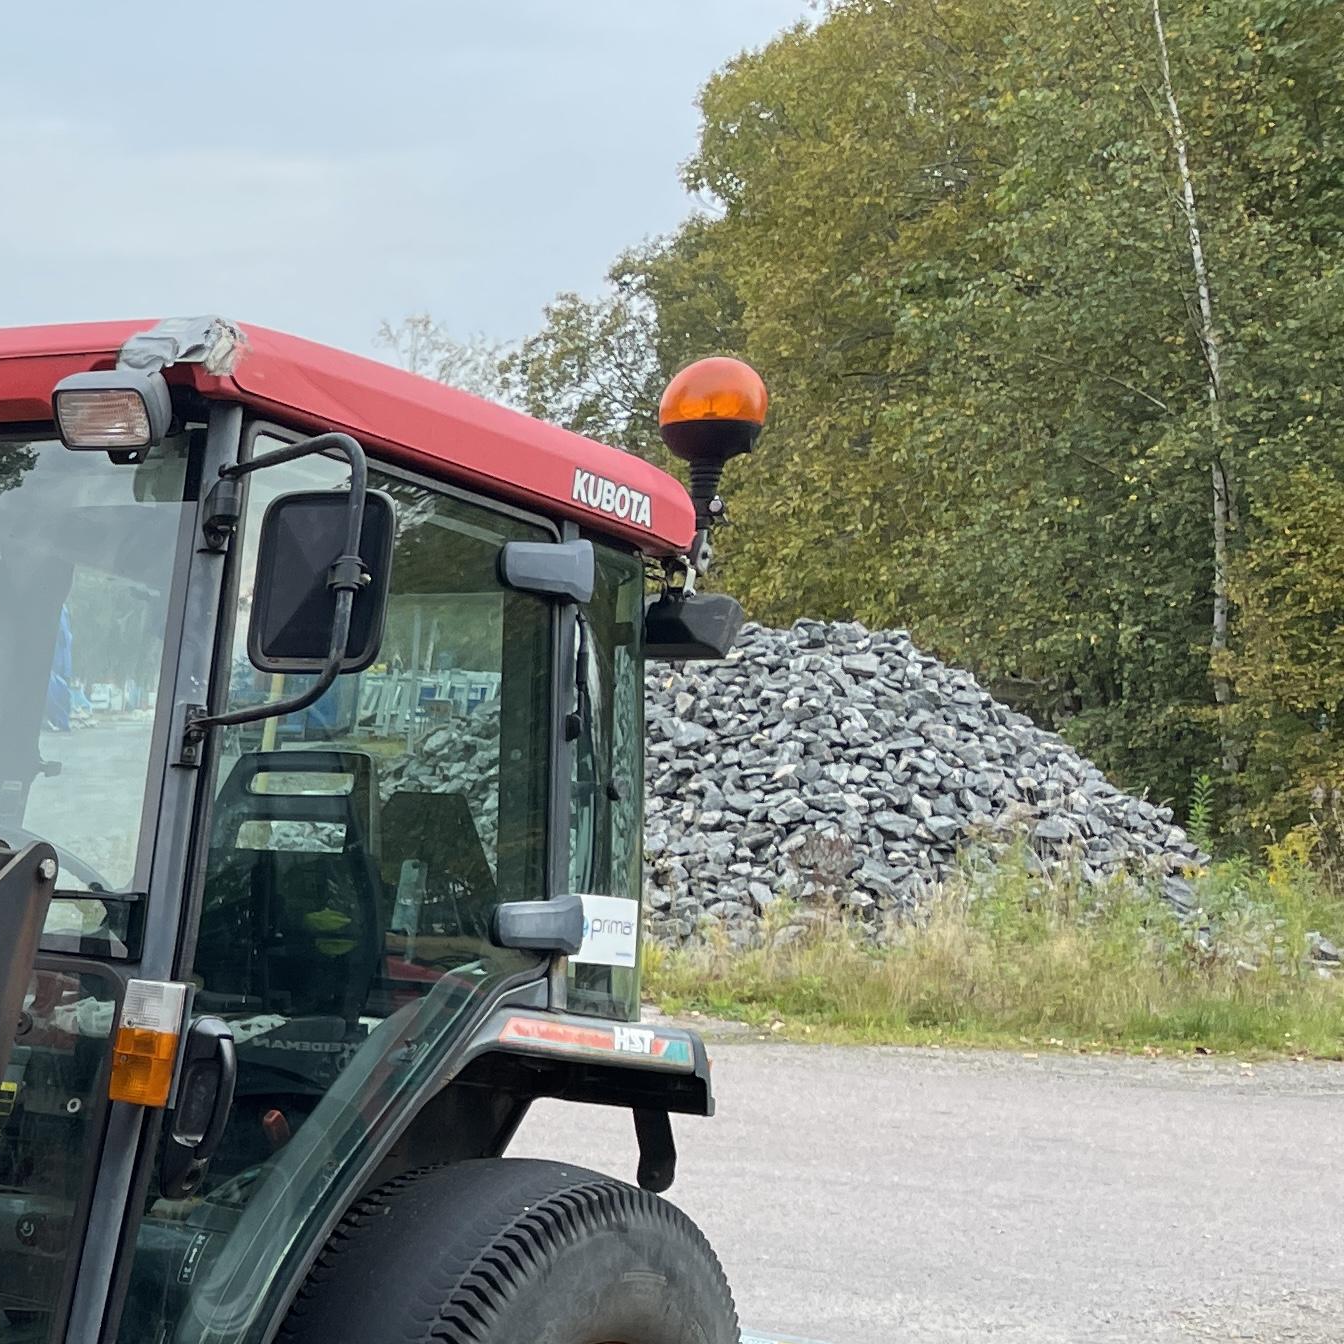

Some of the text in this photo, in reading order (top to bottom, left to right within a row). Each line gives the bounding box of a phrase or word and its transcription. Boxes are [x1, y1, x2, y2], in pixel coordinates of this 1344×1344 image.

[573, 468, 651, 528] KUBOTA
[591, 918, 633, 941] prima
[613, 1026, 655, 1054] HST
